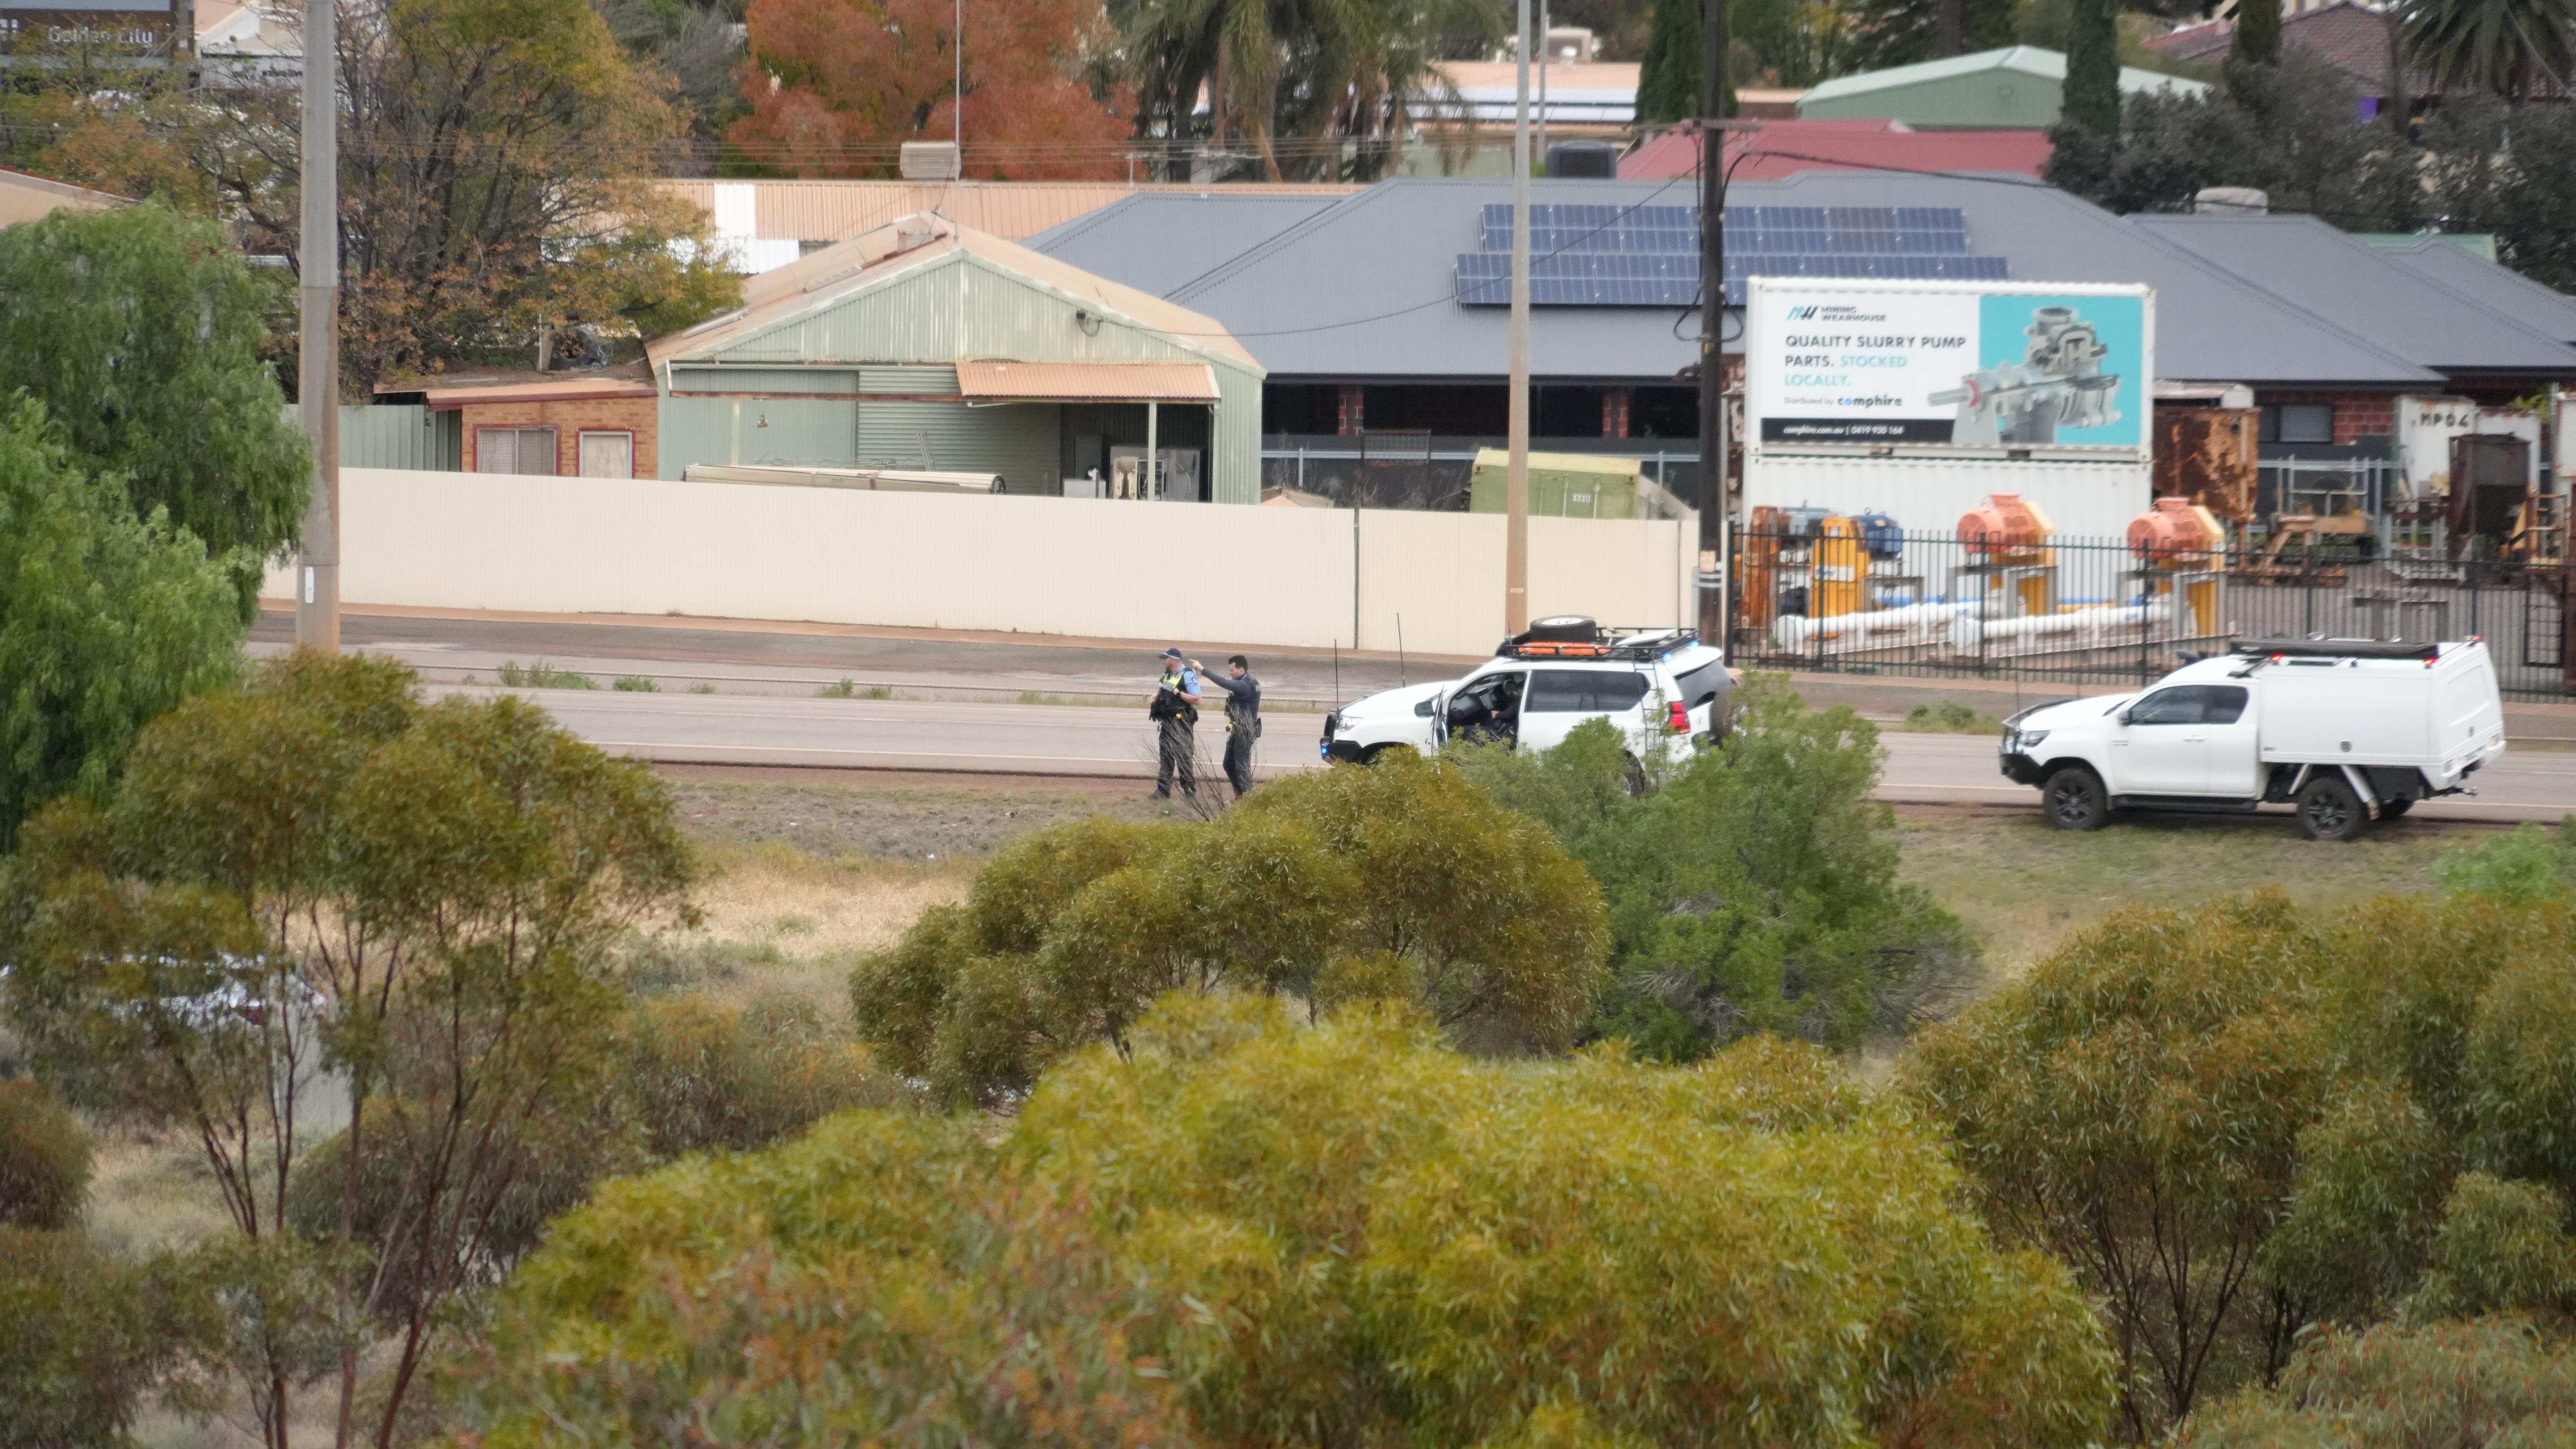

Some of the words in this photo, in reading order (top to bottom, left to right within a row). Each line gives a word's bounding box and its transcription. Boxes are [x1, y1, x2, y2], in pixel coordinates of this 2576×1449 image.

[1821, 314, 1886, 322] WEARHOUSE
[1786, 335, 1851, 348] QUALITY
[1856, 336, 1916, 349] SLURRY
[1921, 337, 1967, 349] PUMP
[1785, 355, 1834, 367] PARTS.
[1840, 355, 1907, 368] STOCKED
[1785, 374, 1851, 387] LOCALLY.
[1825, 397, 1833, 406] by
[1837, 395, 1903, 408] comphire
[1783, 426, 1843, 435] comphire.com.au
